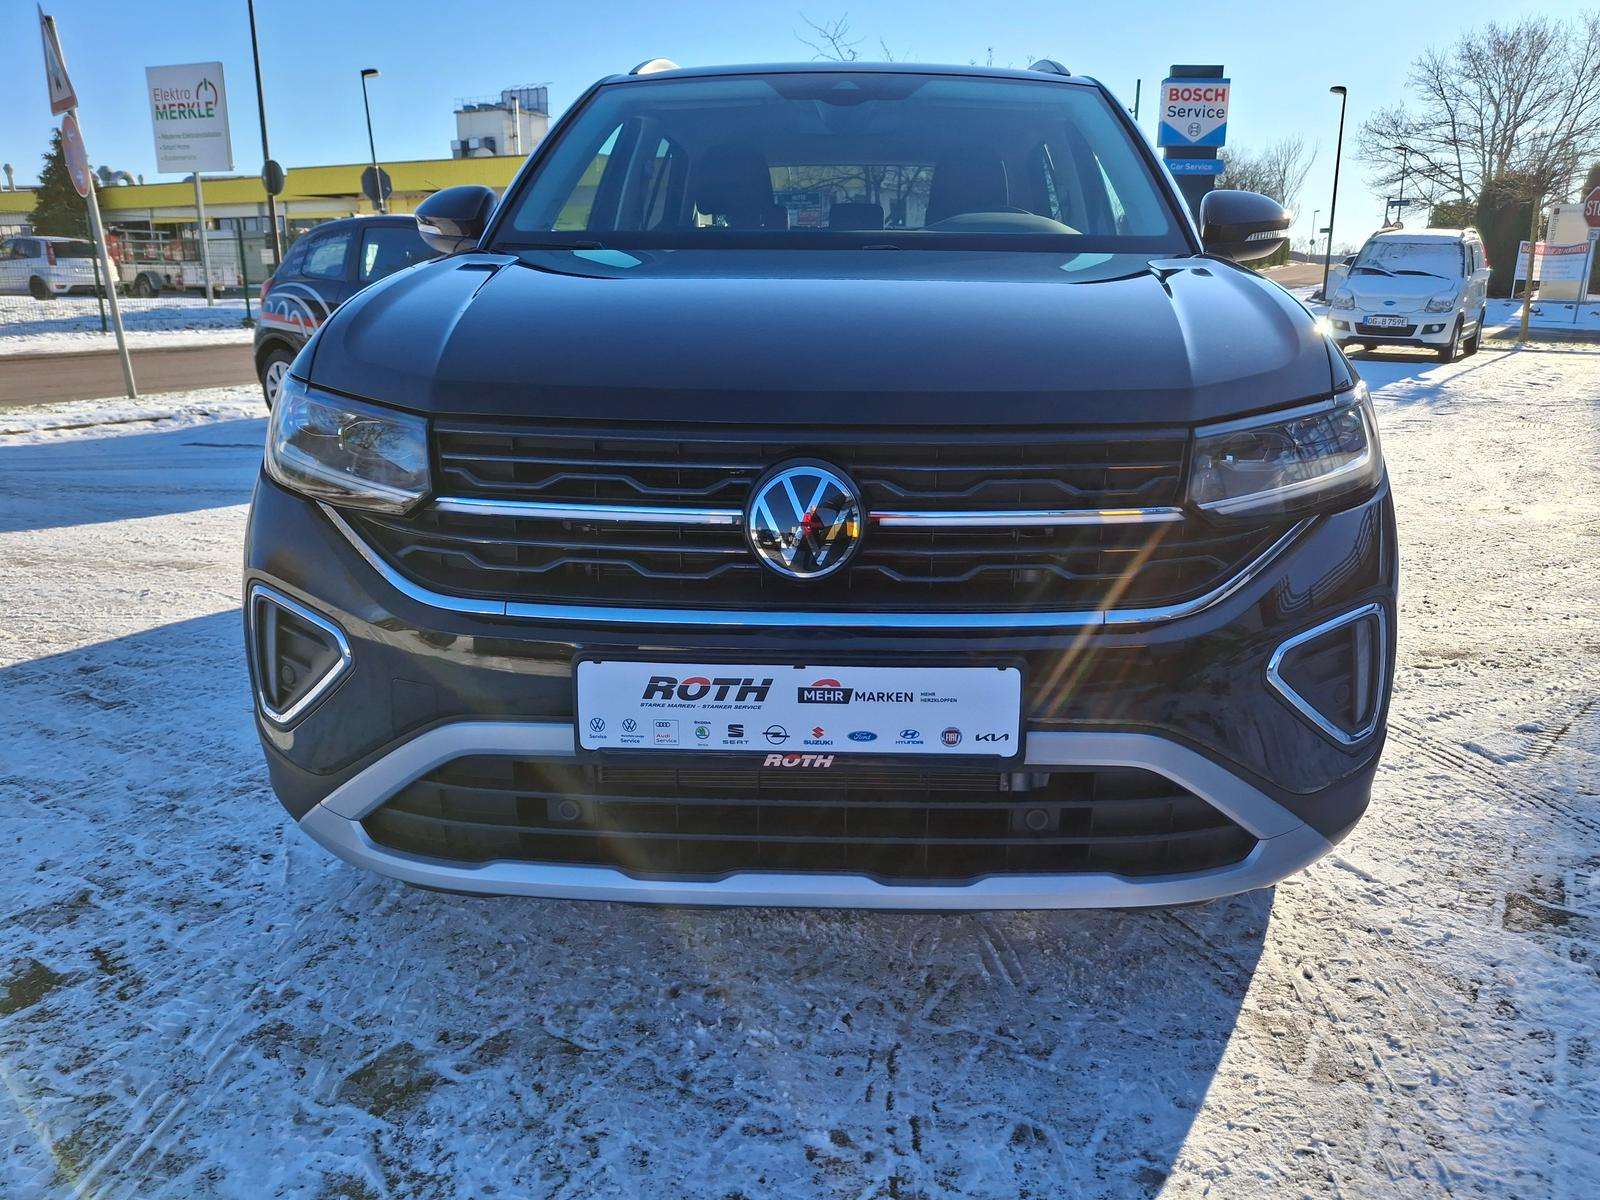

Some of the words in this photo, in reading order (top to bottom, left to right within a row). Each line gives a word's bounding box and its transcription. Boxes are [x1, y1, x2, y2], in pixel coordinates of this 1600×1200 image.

[153, 88, 191, 102] Elektro
[1168, 87, 1226, 102] BOSCH
[155, 101, 215, 120] MERKLE
[1167, 104, 1225, 119] Service
[1170, 162, 1183, 171] Car
[1185, 162, 1213, 171] Service
[641, 676, 774, 702] ROTH
[803, 690, 845, 702] MEHR
[854, 691, 914, 703] MARKEN
[945, 733, 958, 742] FIAT
[763, 753, 835, 768] ROTH
